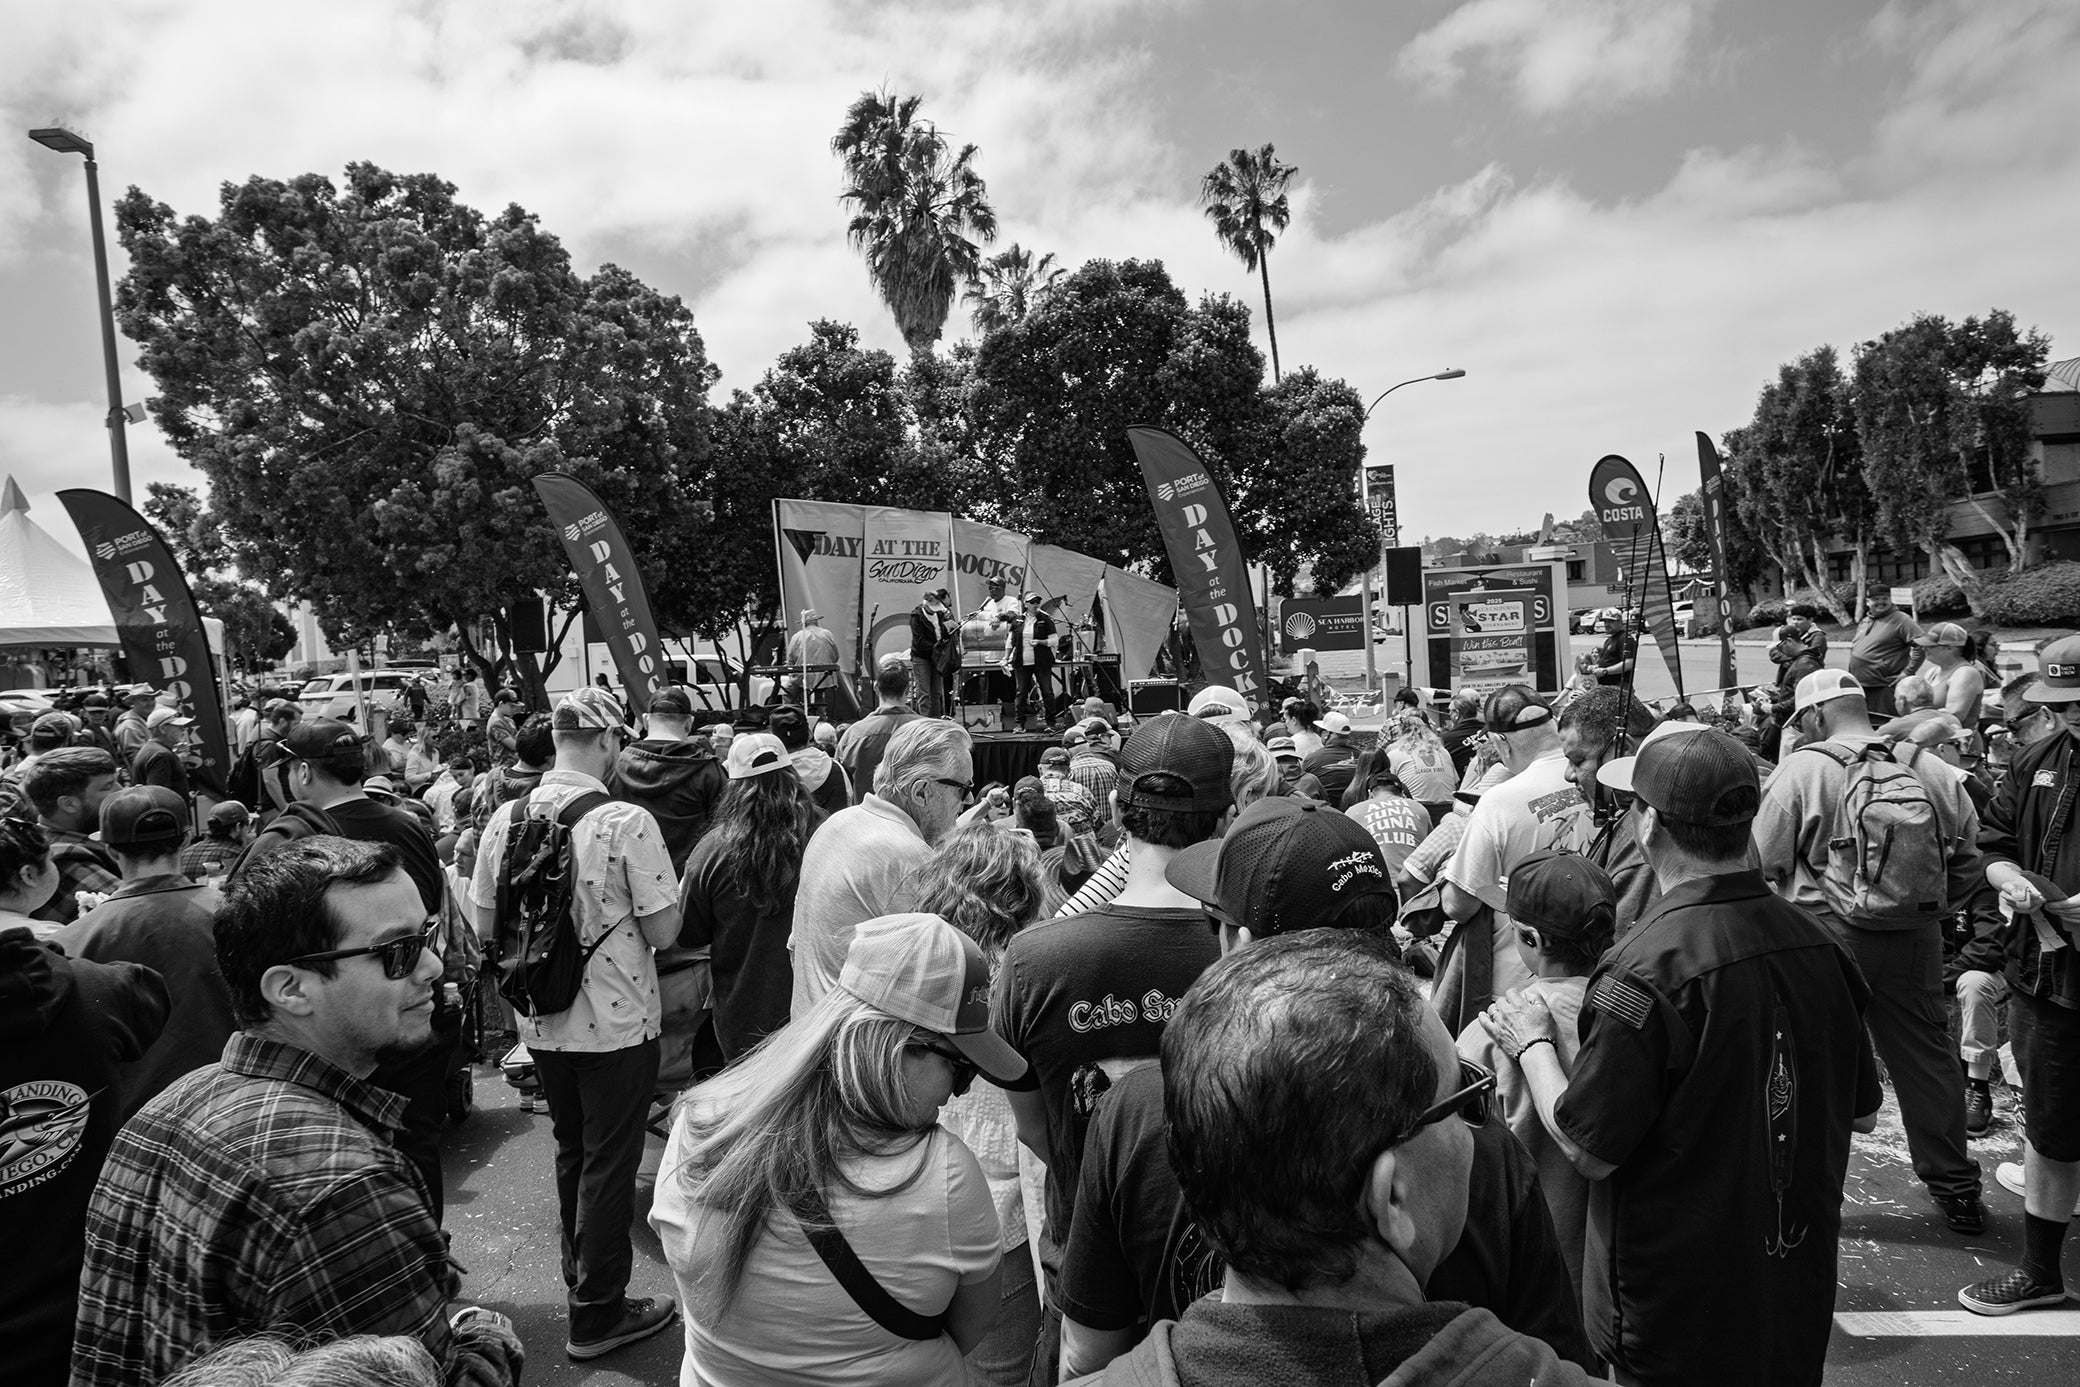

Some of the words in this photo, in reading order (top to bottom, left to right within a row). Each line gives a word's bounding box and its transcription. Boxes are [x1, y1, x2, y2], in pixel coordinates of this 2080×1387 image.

[1173, 474, 1198, 489] PORT
[1176, 484, 1190, 493] SAN
[1189, 478, 1210, 489] DIEGO
[578, 512, 597, 527] PORT
[1603, 506, 1644, 522] COSTA
[1382, 500, 1396, 549] LIGHTS
[114, 531, 140, 546] PORT
[1182, 503, 1217, 572] DAY
[813, 535, 864, 558] DAY
[872, 539, 897, 555] AT
[901, 540, 941, 556] THE
[589, 540, 626, 604] DAY
[868, 560, 901, 579] San
[899, 560, 945, 585] Diego
[1506, 569, 1543, 577] Restaurant
[1209, 576, 1220, 587] at
[1428, 579, 1444, 587] Fish
[1445, 578, 1468, 586] Market
[1519, 578, 1538, 586] Sushi
[126, 560, 168, 625] DAY
[1210, 588, 1227, 600] the
[620, 608, 630, 618] at
[622, 618, 636, 630] the
[156, 629, 169, 639] at
[157, 641, 176, 652] the
[1463, 640, 1480, 651] Win
[1482, 637, 1498, 650] this
[1367, 799, 1410, 813] ANTI
[1364, 806, 1415, 824] TUNA
[1367, 815, 1418, 835] TUNA
[1372, 831, 1416, 847] CLUB
[1332, 871, 1353, 891] Cabo
[1354, 863, 1383, 878] Mexico
[1069, 993, 1138, 1033] Cabo
